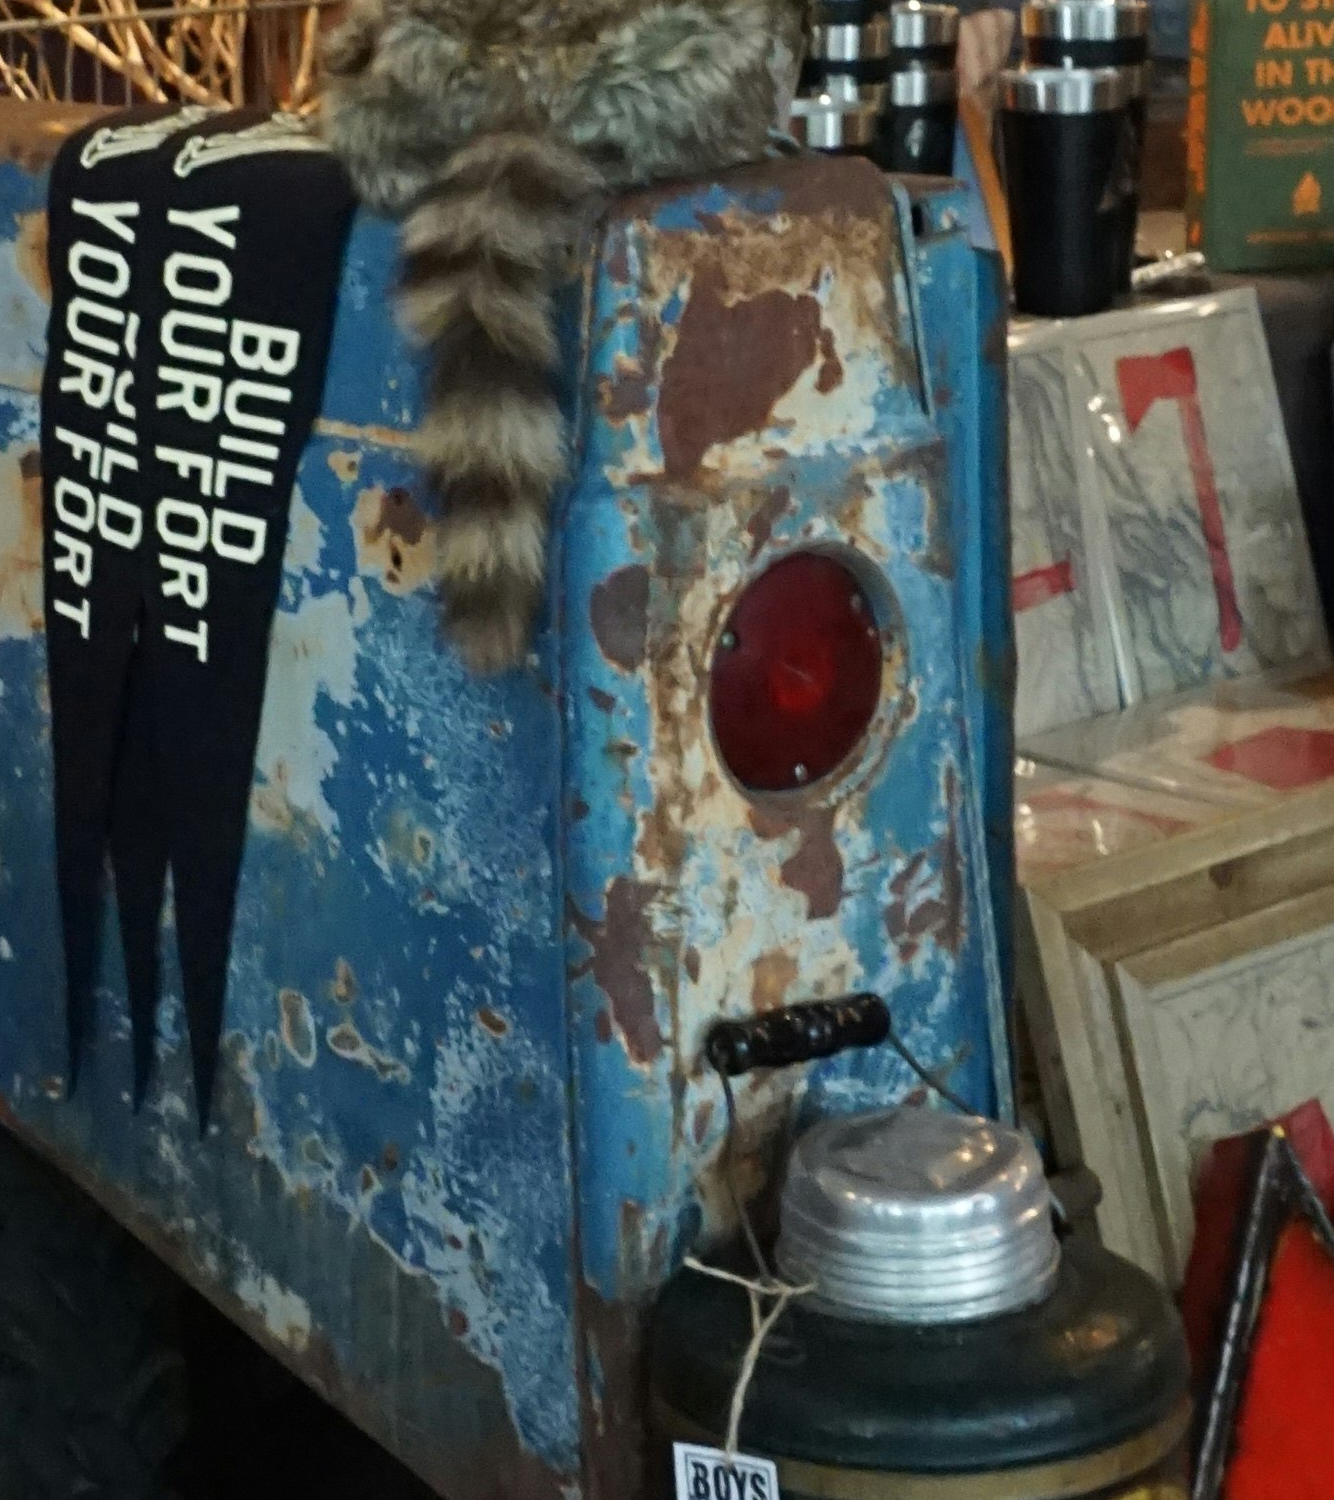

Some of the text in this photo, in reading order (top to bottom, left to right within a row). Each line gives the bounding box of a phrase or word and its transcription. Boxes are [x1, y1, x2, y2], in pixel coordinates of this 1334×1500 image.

[1255, 60, 1293, 87] IN
[53, 198, 140, 639] YOUR FORT
[155, 205, 240, 663] YOUR FORT
[212, 317, 301, 566] BUILD
